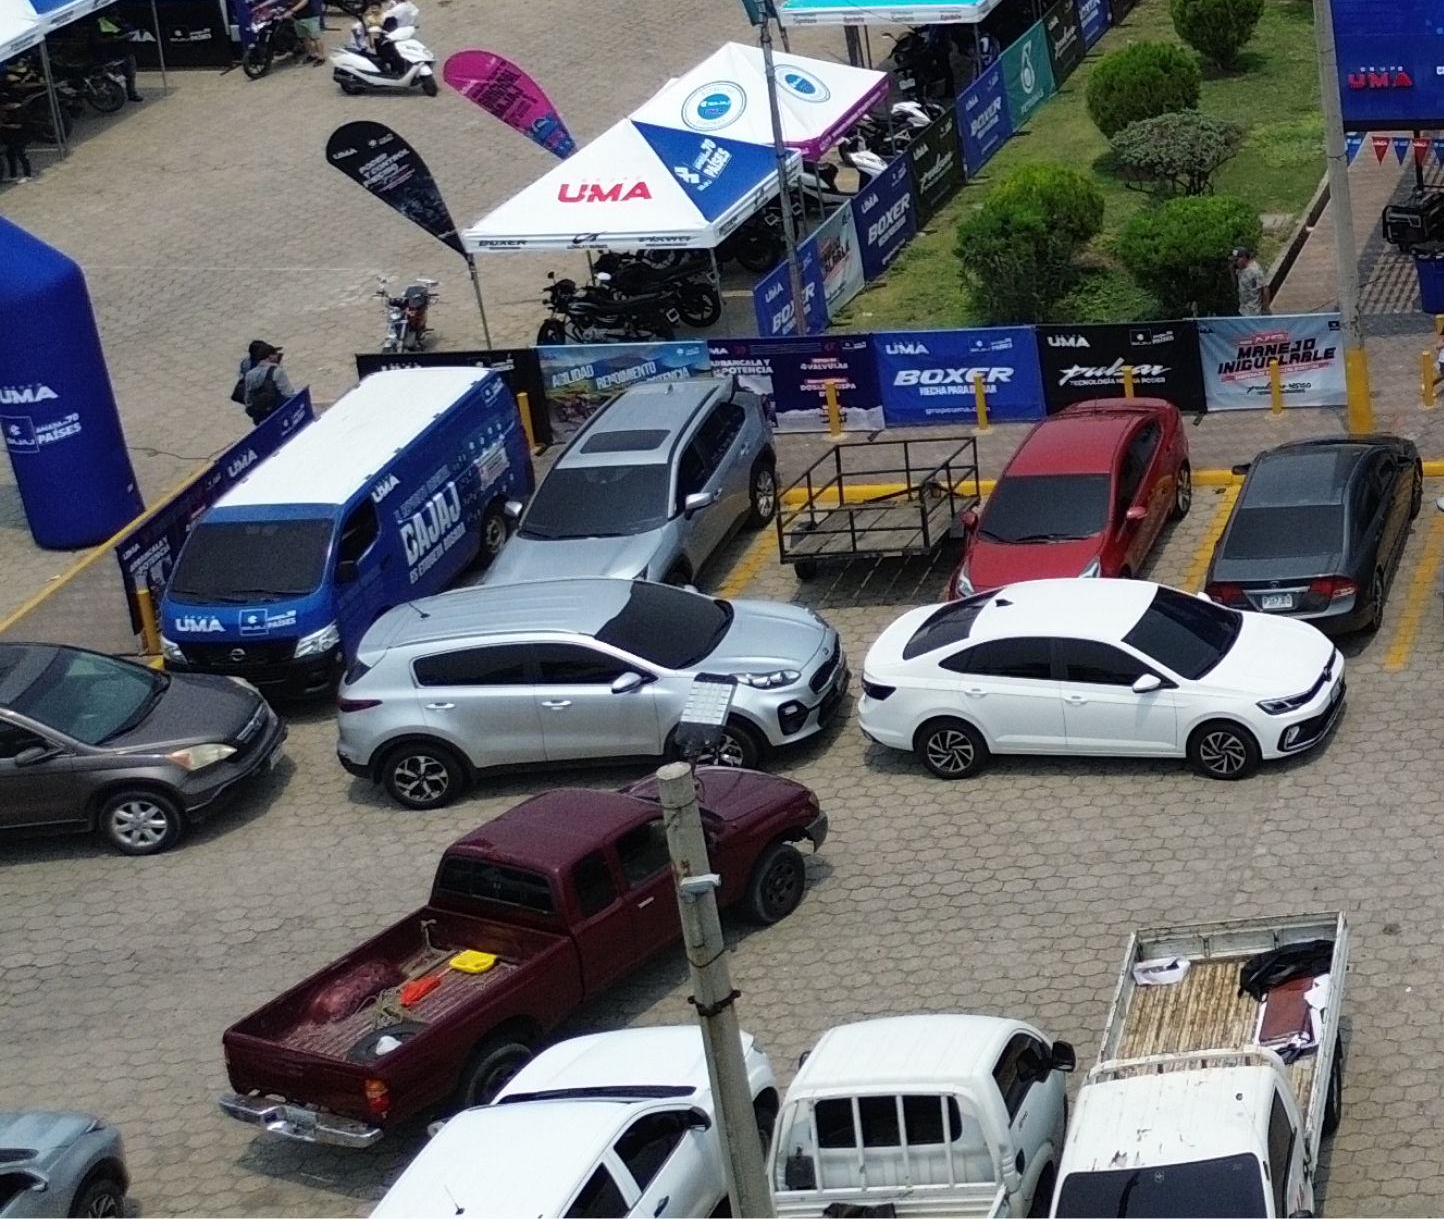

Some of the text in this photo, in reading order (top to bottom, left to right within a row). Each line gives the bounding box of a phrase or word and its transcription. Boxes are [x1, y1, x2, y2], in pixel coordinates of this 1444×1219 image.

[1348, 72, 1414, 89] UMA
[970, 96, 1003, 137] BOXER
[557, 181, 653, 203] UMA
[861, 194, 880, 215] UMA
[867, 194, 912, 245] BOXER
[884, 343, 931, 356] UMA
[1047, 335, 1091, 349] UMA
[1236, 337, 1317, 361] MANEJO
[551, 364, 595, 389] AGILIDAD
[596, 360, 658, 390] RENDIMIENTO
[729, 365, 775, 375] POTENCIA
[893, 366, 1016, 387] BOXER
[919, 385, 967, 397] HECHA PARA
[38, 422, 83, 445] PAÍSES
[227, 449, 259, 478] UMA
[371, 476, 400, 504] UMA
[175, 617, 226, 632] UMA
